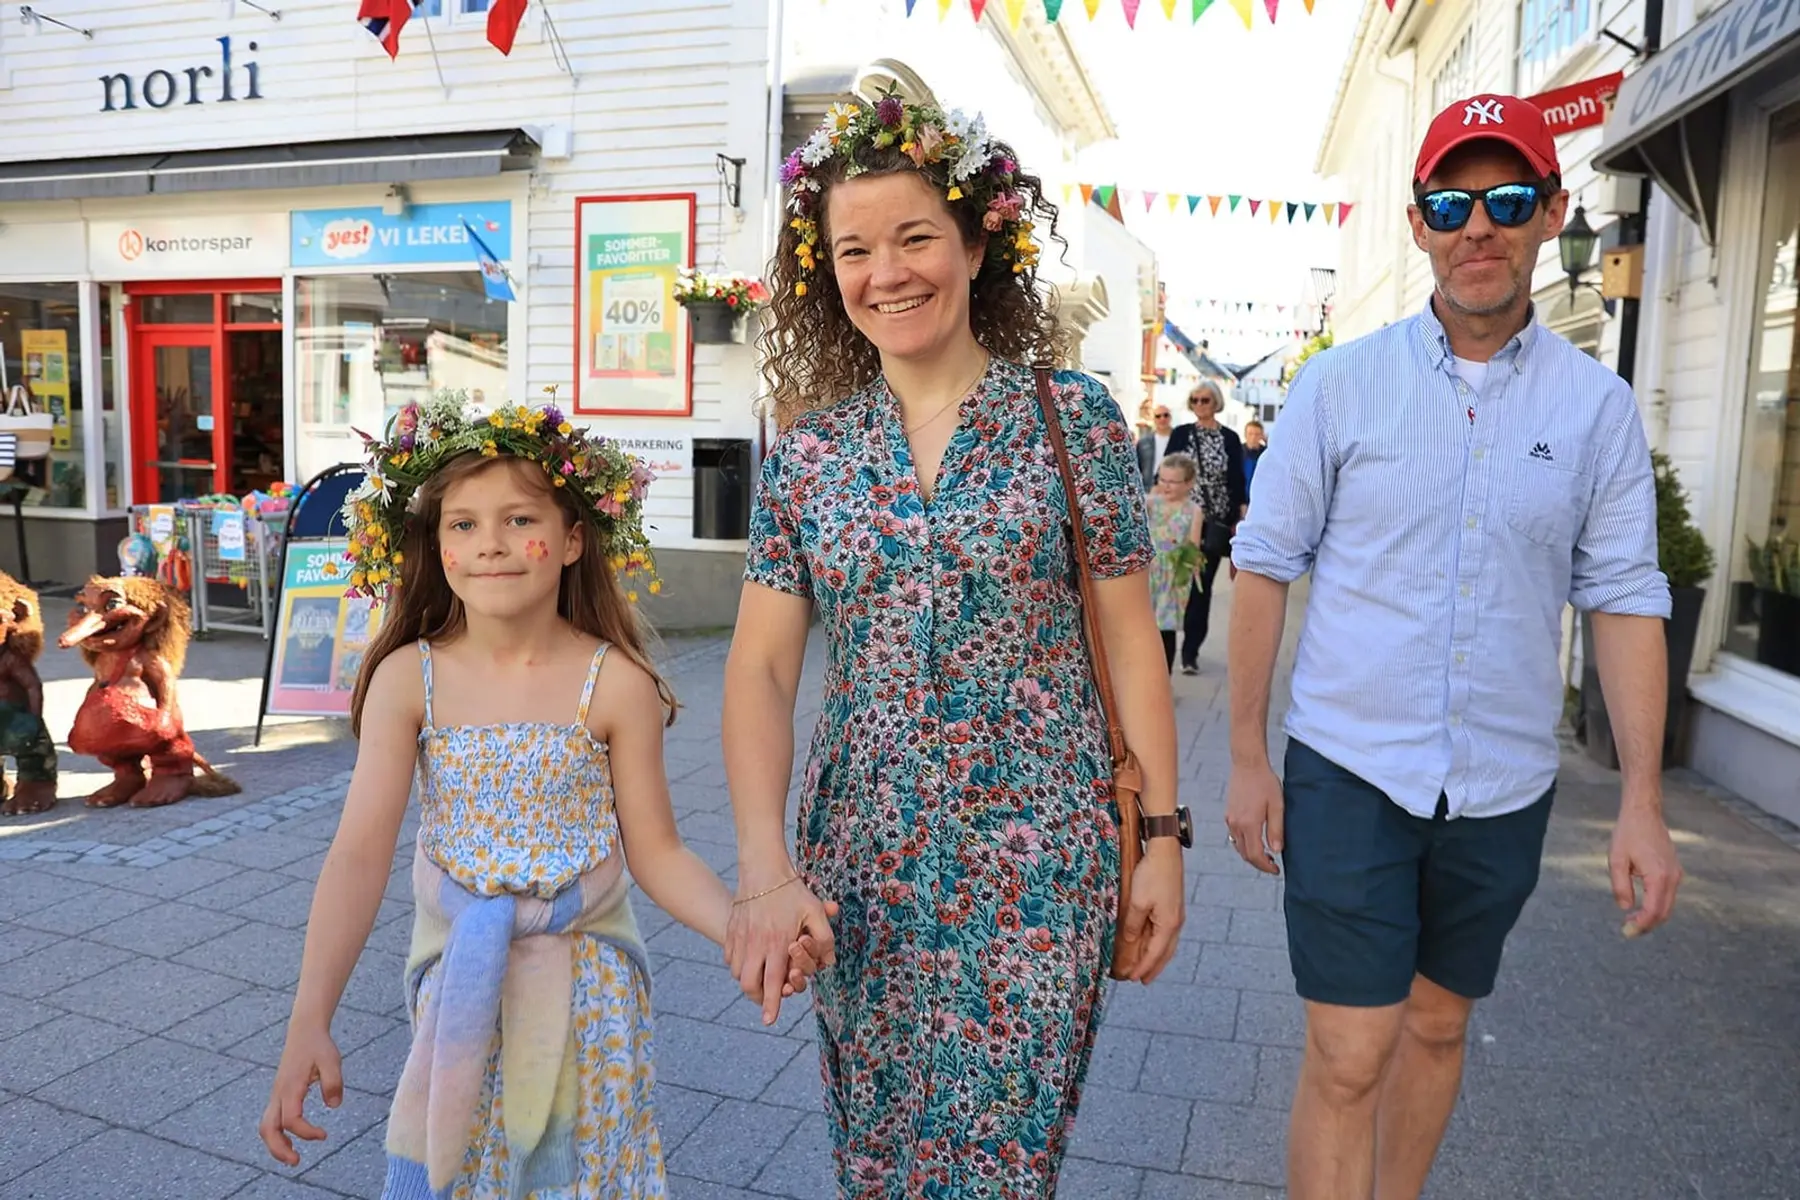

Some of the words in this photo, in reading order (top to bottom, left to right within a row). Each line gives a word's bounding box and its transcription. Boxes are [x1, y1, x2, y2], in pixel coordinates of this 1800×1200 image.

[99, 36, 263, 112] norli
[1462, 98, 1504, 126] NY
[1542, 95, 1597, 126] mph
[146, 236, 253, 255] kontorspar
[327, 224, 370, 250] yes!
[377, 227, 399, 246] VI
[603, 236, 662, 252] SOMMER-
[596, 248, 671, 266] FAVORITTER
[605, 299, 660, 325] 40%
[306, 552, 356, 569] SOMM
